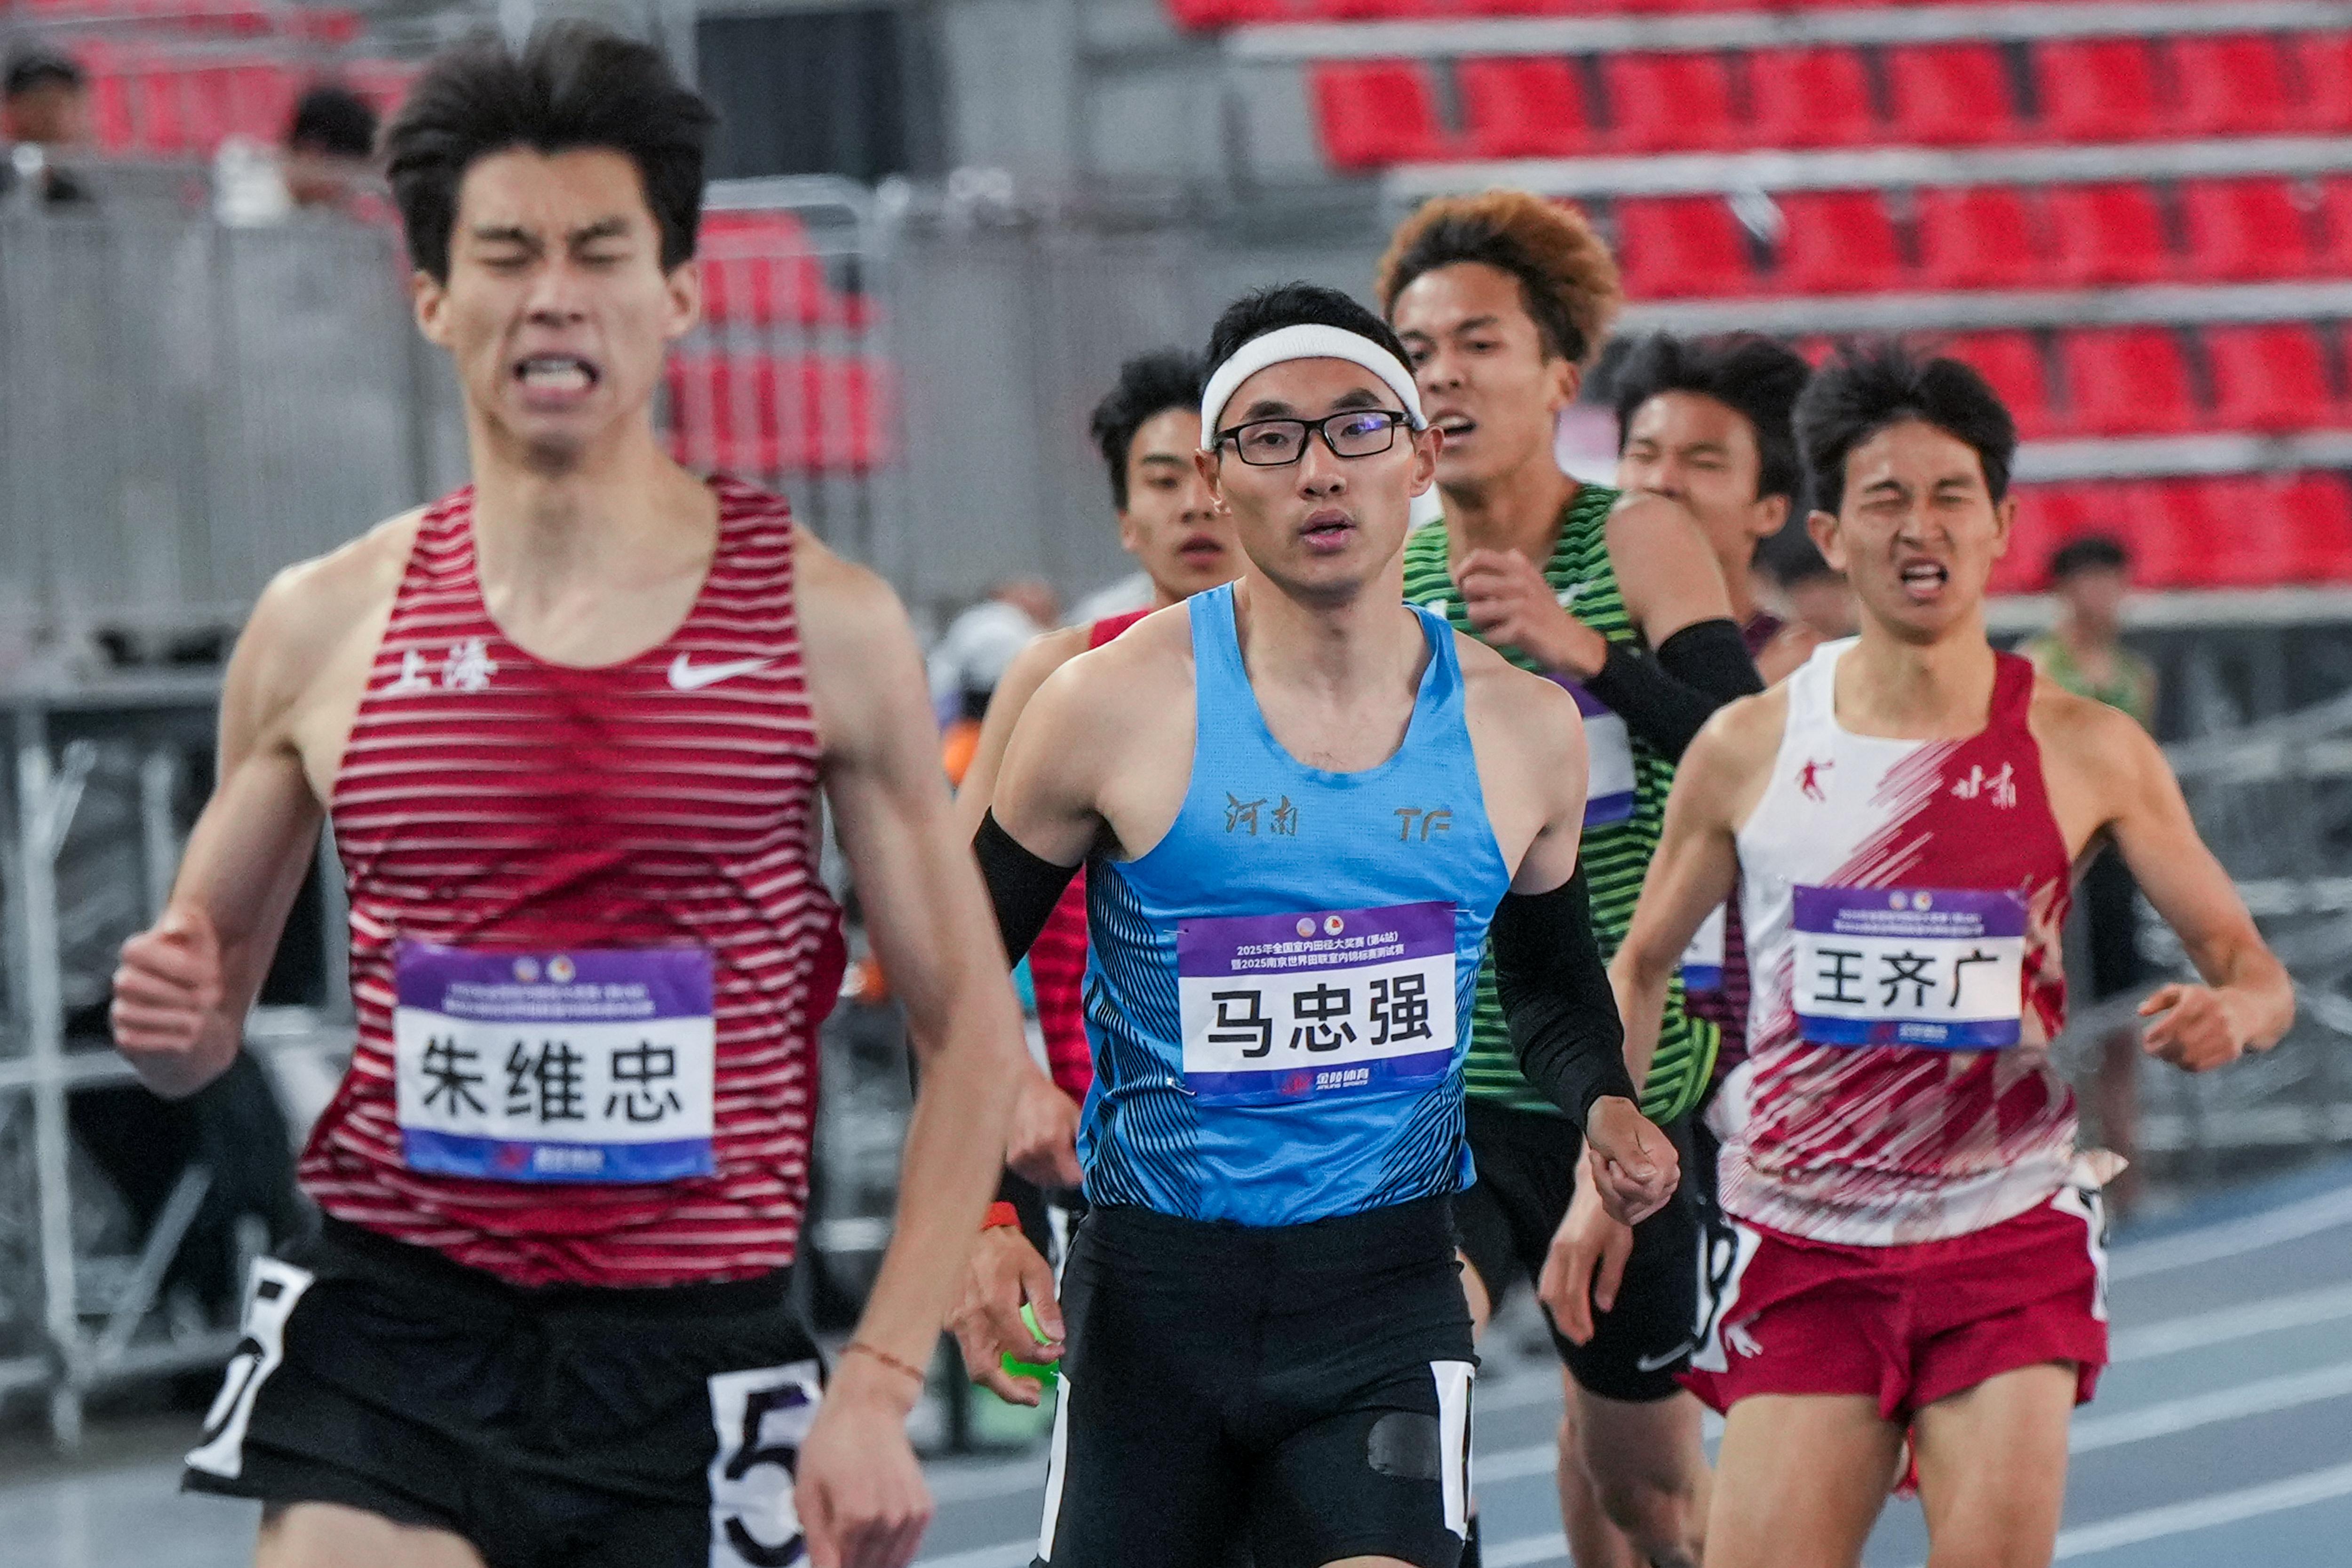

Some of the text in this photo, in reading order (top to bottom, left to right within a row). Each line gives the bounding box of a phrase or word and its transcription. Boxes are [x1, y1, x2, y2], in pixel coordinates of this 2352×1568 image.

[377, 637, 499, 693] 上海
[1224, 791, 1297, 836] 河南
[1394, 807, 1453, 841] TF
[1814, 947, 2000, 1008] 王齐广
[1208, 973, 1433, 1058] 马忠强
[422, 1036, 682, 1124] 朱维忠
[724, 1383, 809, 1568] 5
